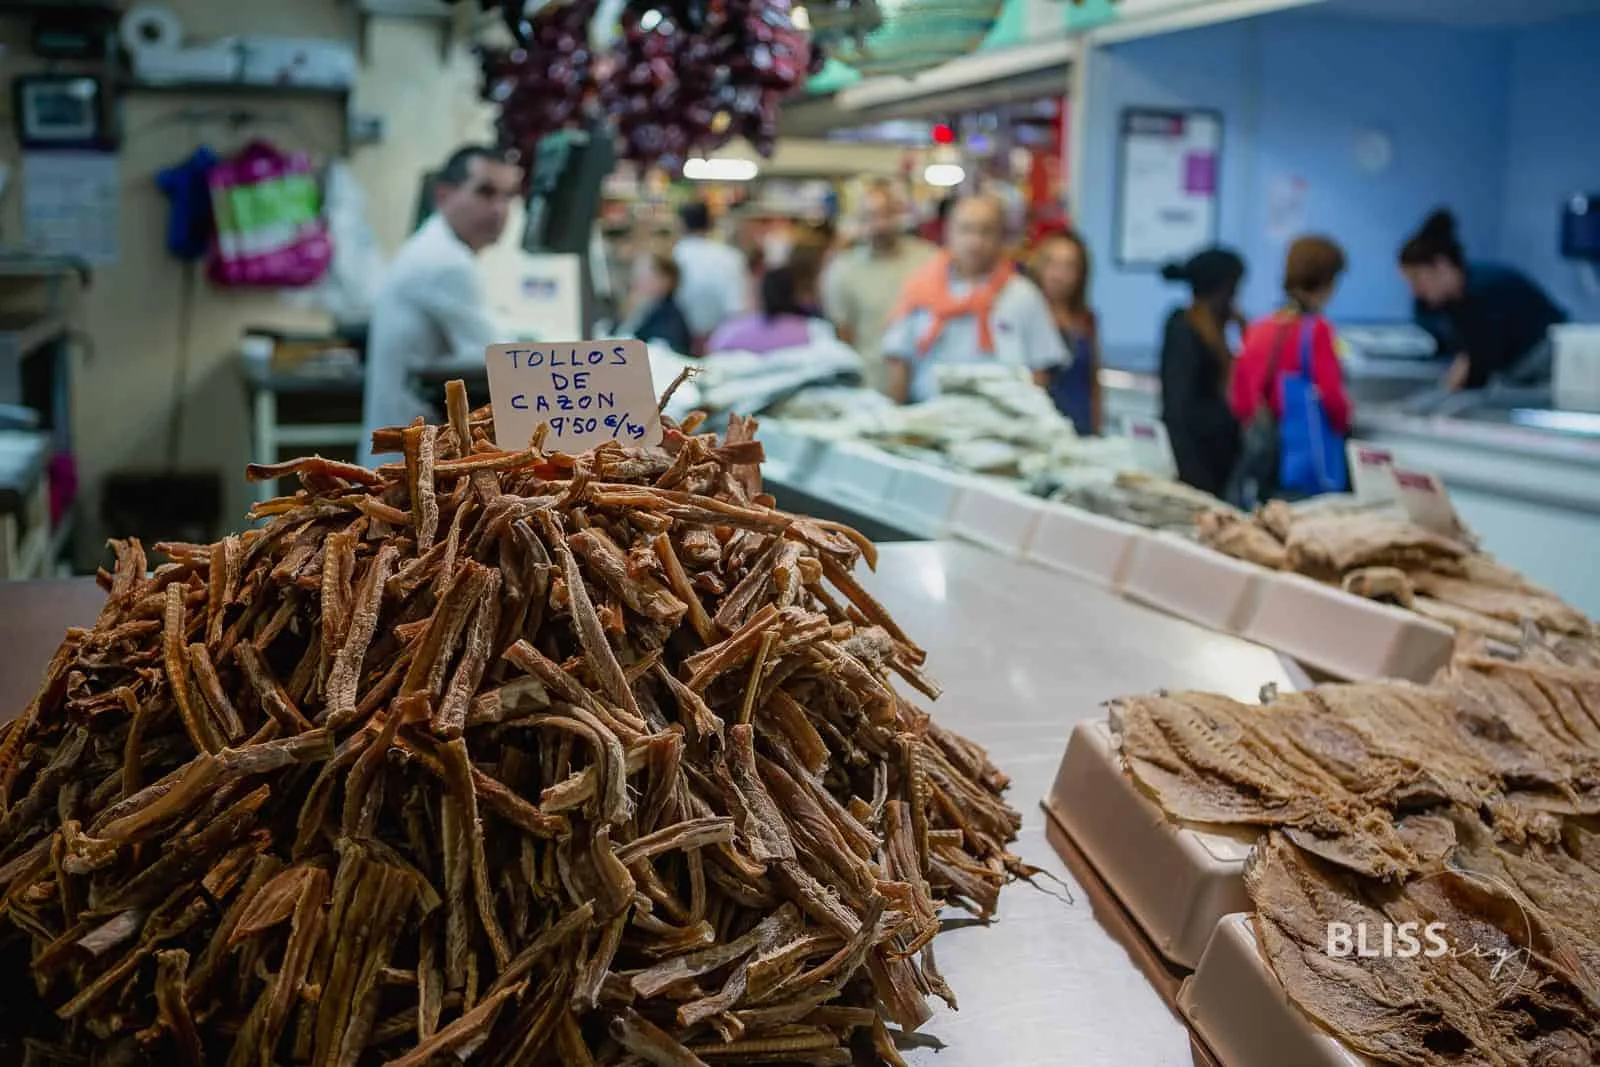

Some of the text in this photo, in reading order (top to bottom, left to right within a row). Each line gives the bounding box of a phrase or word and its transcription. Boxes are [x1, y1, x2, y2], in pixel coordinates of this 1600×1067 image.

[505, 346, 627, 369] TOLLOS
[551, 371, 591, 391] DE
[511, 392, 615, 412] CAZON
